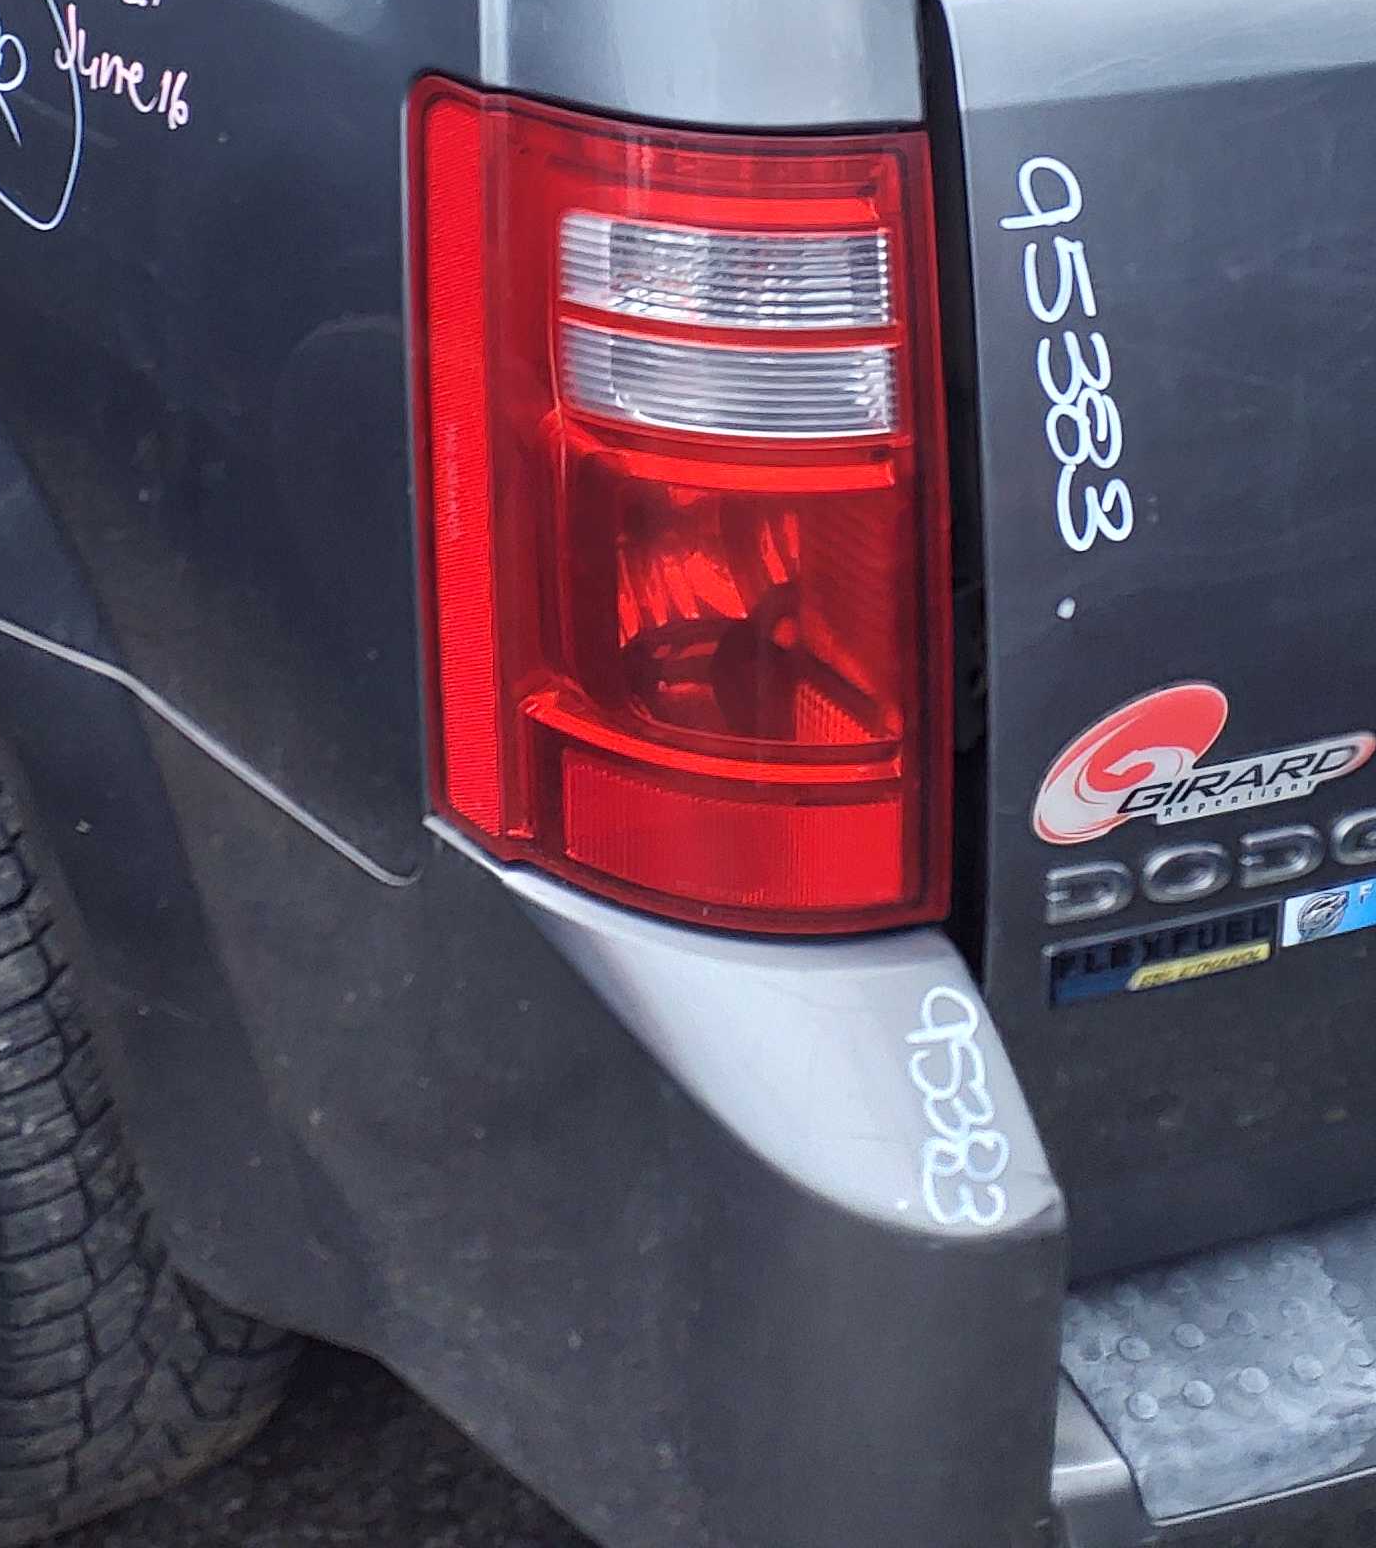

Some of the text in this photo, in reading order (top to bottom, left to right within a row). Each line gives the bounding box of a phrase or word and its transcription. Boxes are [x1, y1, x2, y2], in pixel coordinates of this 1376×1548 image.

[999, 155, 1135, 553] 95383
[1117, 744, 1358, 814] GIRARD
[1163, 780, 1315, 818] Repentigny
